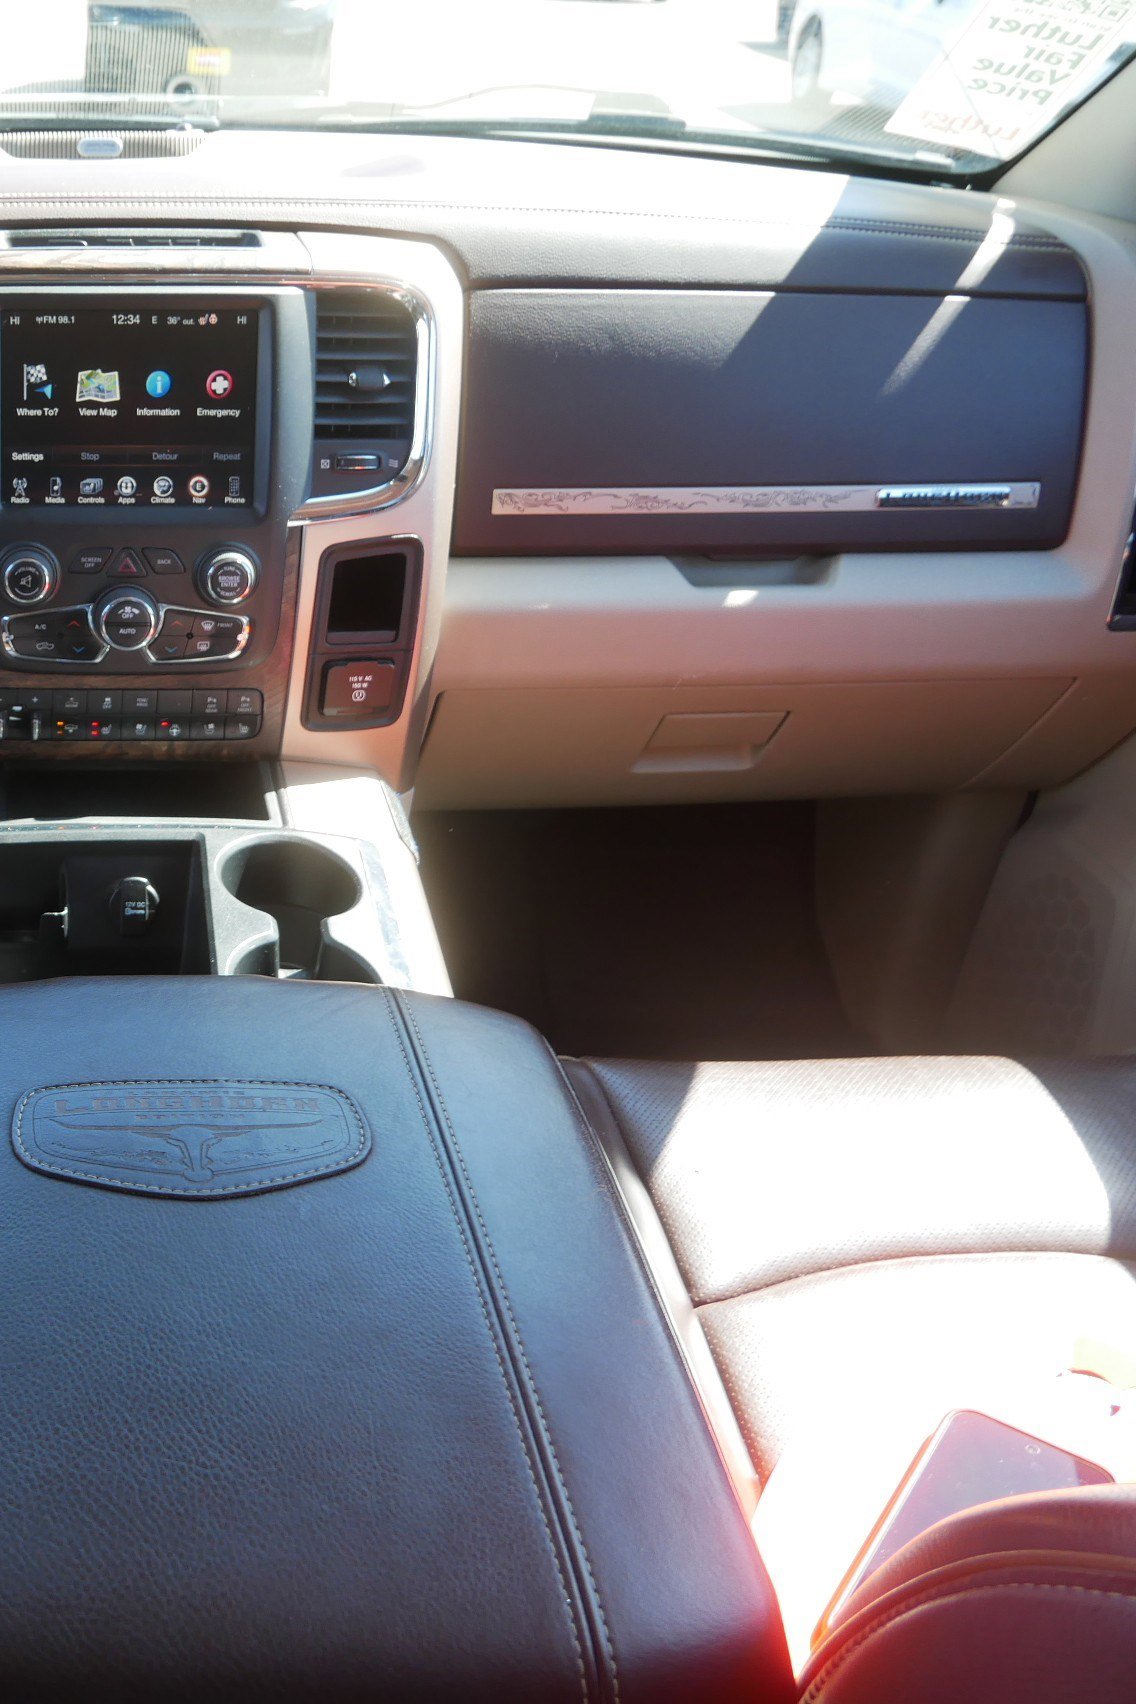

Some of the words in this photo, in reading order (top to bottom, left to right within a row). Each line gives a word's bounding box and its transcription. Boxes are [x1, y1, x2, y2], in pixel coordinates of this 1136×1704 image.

[9, 316, 20, 325] HI
[43, 316, 56, 324] FM
[58, 316, 75, 324] 98.1
[111, 314, 141, 325] 12:34
[152, 316, 158, 324] E
[236, 316, 247, 325] HI
[16, 407, 42, 416] Where
[43, 407, 59, 416] To?
[78, 407, 98, 417] View
[99, 407, 118, 418] Map
[136, 407, 180, 417] Information
[196, 407, 241, 418] Emergency
[11, 452, 44, 463] Settings
[80, 452, 100, 462] Stop
[152, 452, 179, 460] Detour
[213, 452, 241, 462] Repeat
[11, 496, 30, 504] Radio
[45, 496, 66, 504] Media
[77, 496, 106, 504] Controls
[117, 496, 136, 505] Apps
[150, 496, 176, 504] Climate
[192, 496, 206, 504] Nav
[224, 496, 246, 504] Phone
